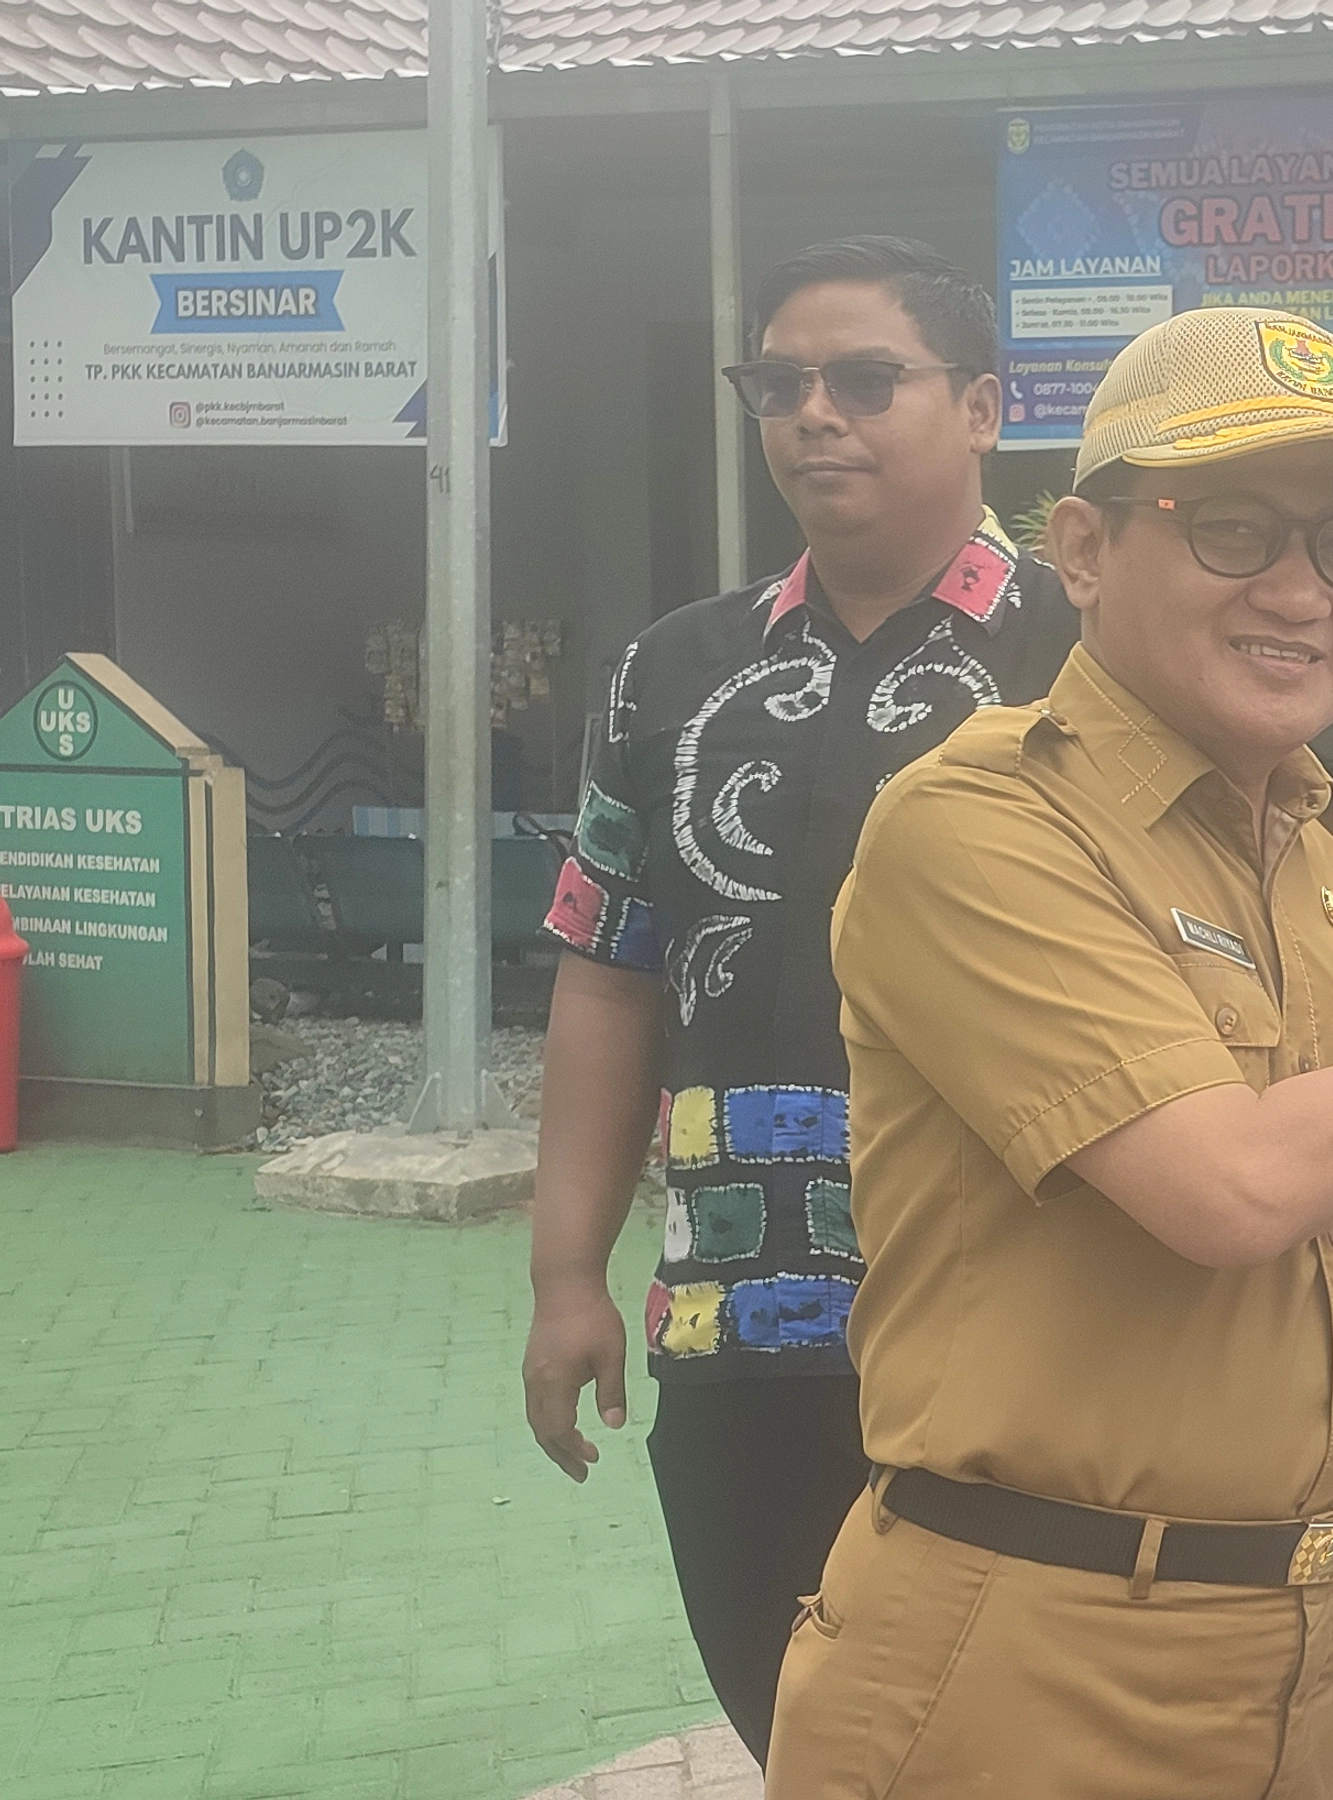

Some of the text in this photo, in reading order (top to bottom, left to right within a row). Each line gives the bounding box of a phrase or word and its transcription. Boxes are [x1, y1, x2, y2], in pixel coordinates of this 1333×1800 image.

[1110, 157, 1227, 190] SEMUA
[82, 207, 418, 265] KANTIN UP2K
[1010, 256, 1161, 277] JAM LAYANAN
[176, 288, 317, 318] BERSINAR
[1238, 290, 1283, 306] ANDA
[85, 361, 417, 380] TP. PKK KECAMATAN BANJARMASIN BARAT
[1009, 360, 1062, 375] Layanan
[41, 711, 90, 733] UKS
[0, 805, 142, 835] TRIAS UKS
[0, 851, 160, 873] ENDIDIKAN KESEHATAN
[0, 884, 156, 907] ELAYANAN KESEHATAN
[75, 921, 168, 943] LINGKUNGAN
[58, 952, 103, 971] SEHAT
